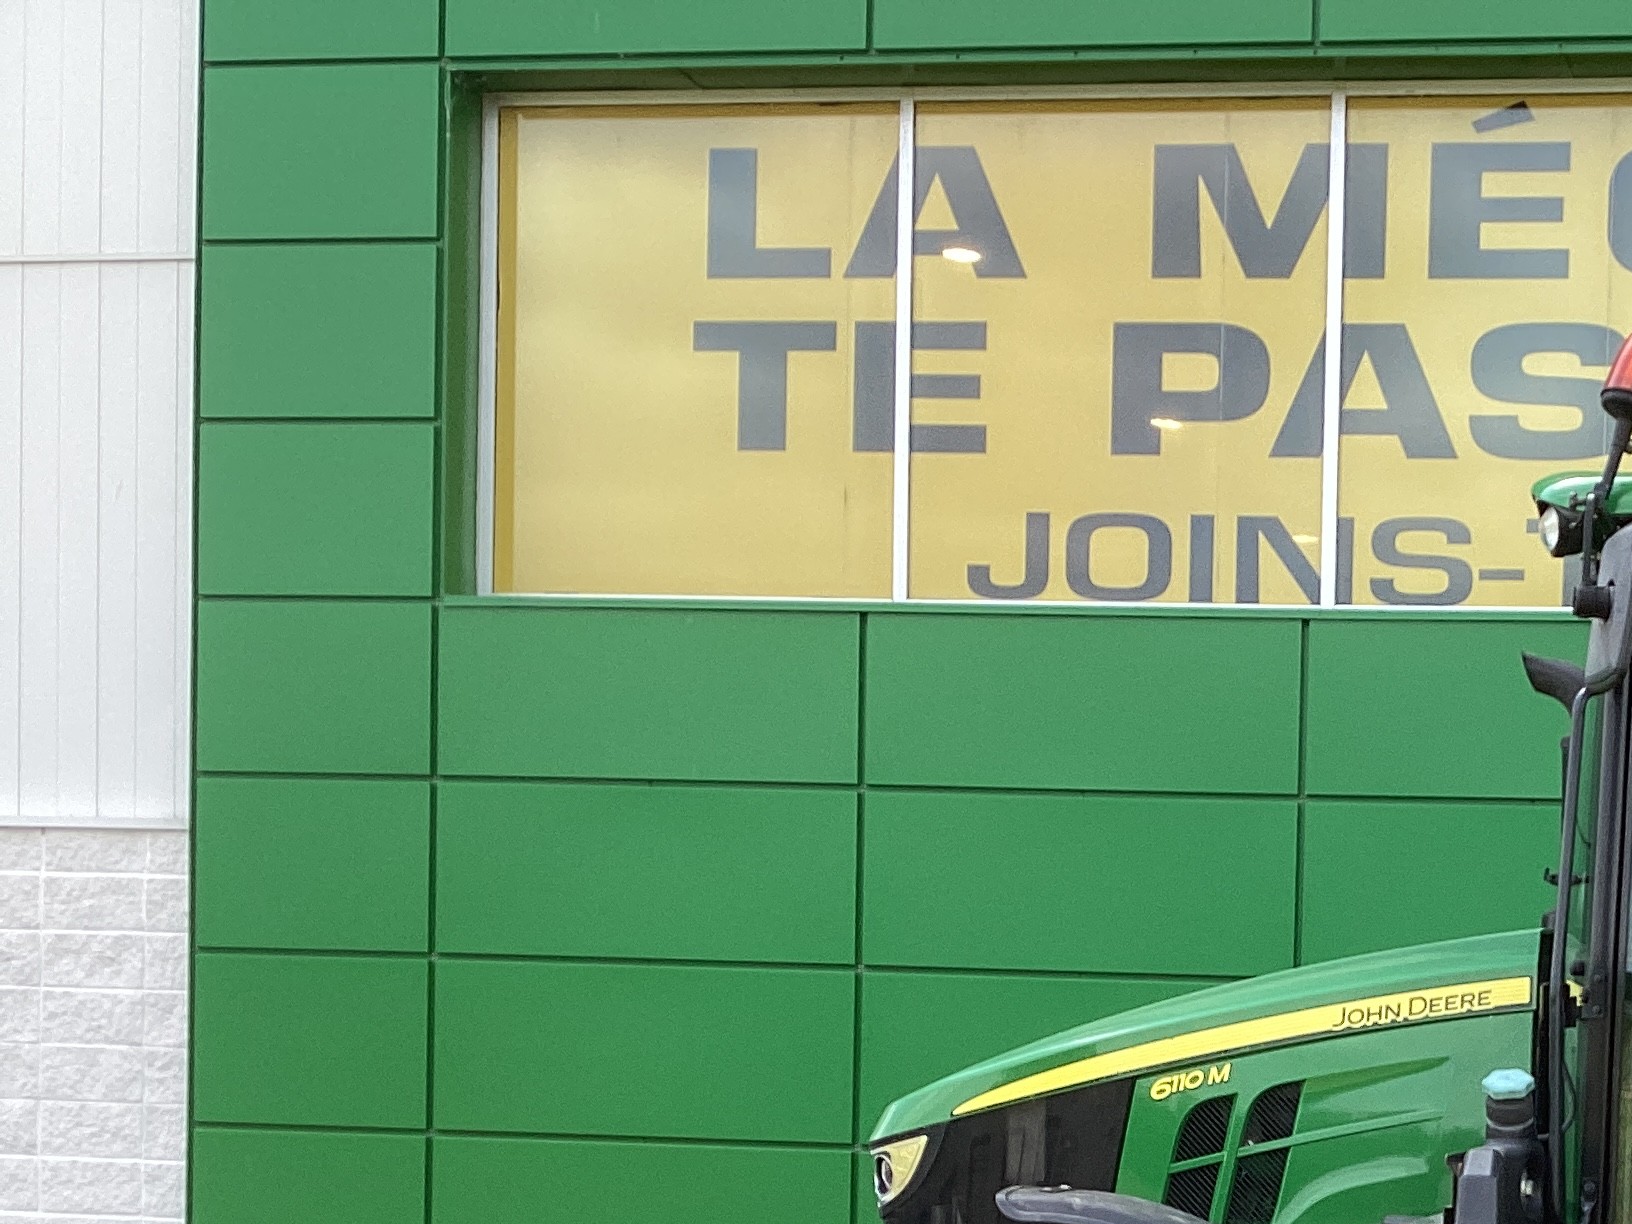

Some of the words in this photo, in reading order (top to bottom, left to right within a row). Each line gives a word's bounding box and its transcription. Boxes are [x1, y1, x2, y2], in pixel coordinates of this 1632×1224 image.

[705, 145, 1027, 280] LA
[692, 319, 988, 454] TE
[1332, 1001, 1402, 1029] JOHN
[1408, 989, 1493, 1017] DEERE
[1149, 1069, 1205, 1101] 6110
[1207, 1062, 1232, 1086] M
